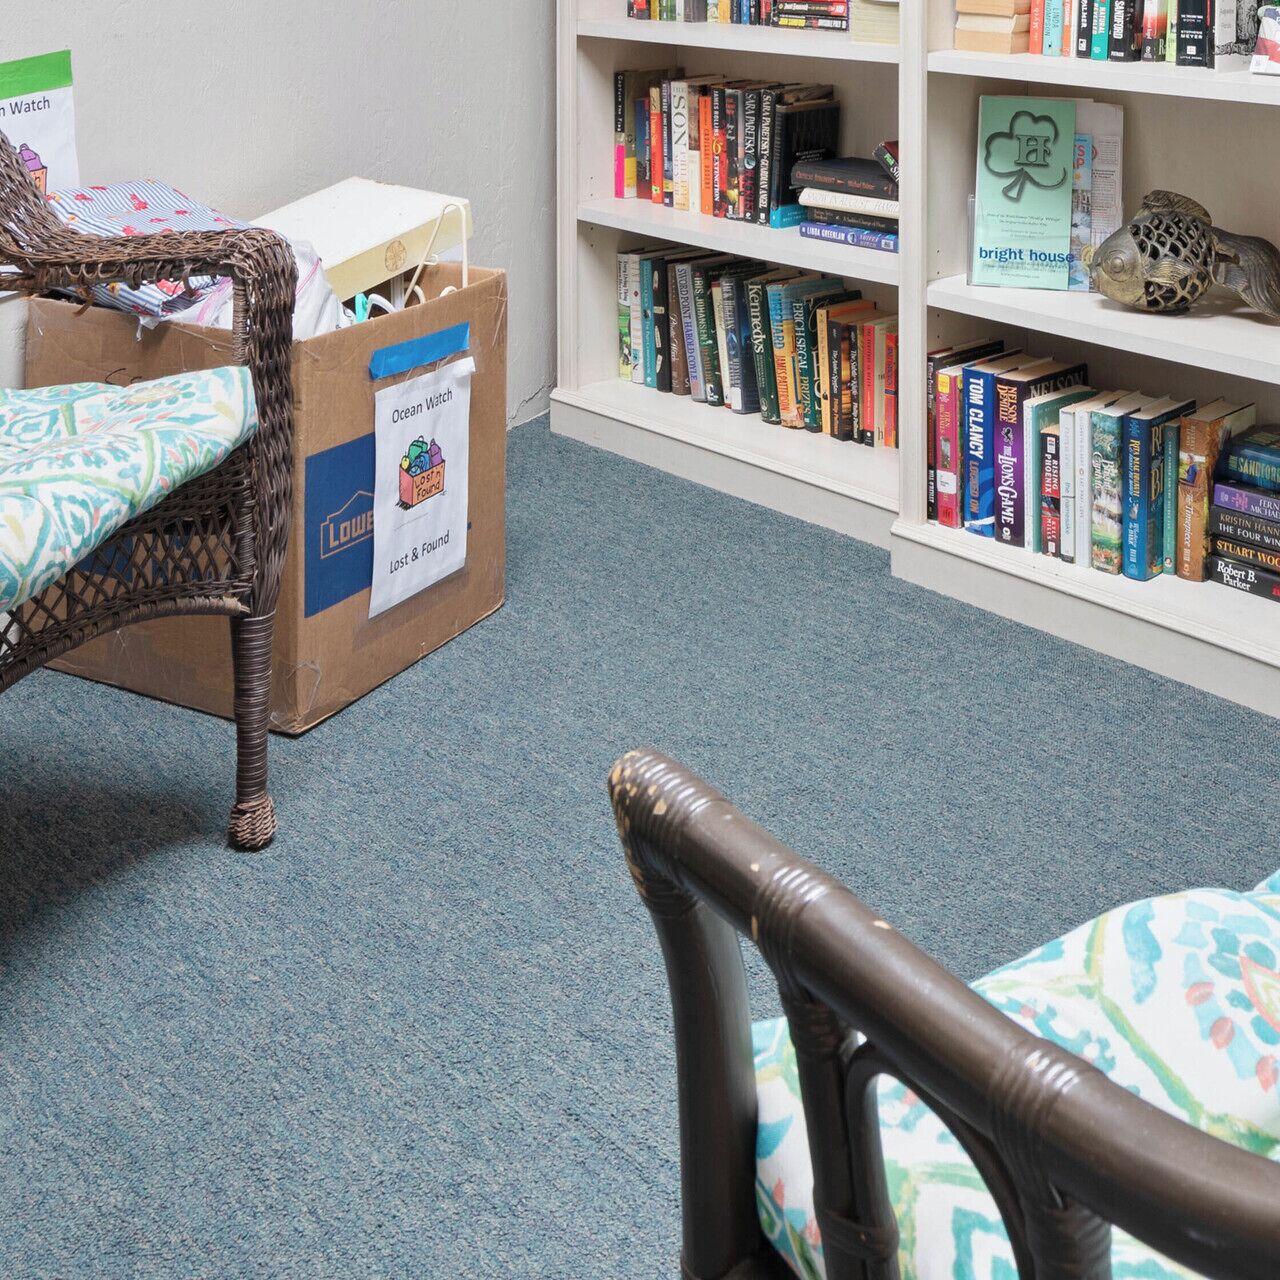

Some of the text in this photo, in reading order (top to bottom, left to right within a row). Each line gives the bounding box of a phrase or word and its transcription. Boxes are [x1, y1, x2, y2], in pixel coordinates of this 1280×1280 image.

[979, 247, 1075, 263] bright house
[392, 388, 453, 424] Ocean Watch
[968, 377, 984, 460] TOM CLANCY
[1044, 453, 1052, 493] PHOENIX
[1051, 459, 1059, 491] RISING
[1259, 499, 1280, 510] FERN
[1220, 513, 1252, 528] KRISTIN
[389, 530, 450, 574] Lost & Found
[1217, 541, 1255, 561] STUART
[1223, 573, 1251, 592] Parker
